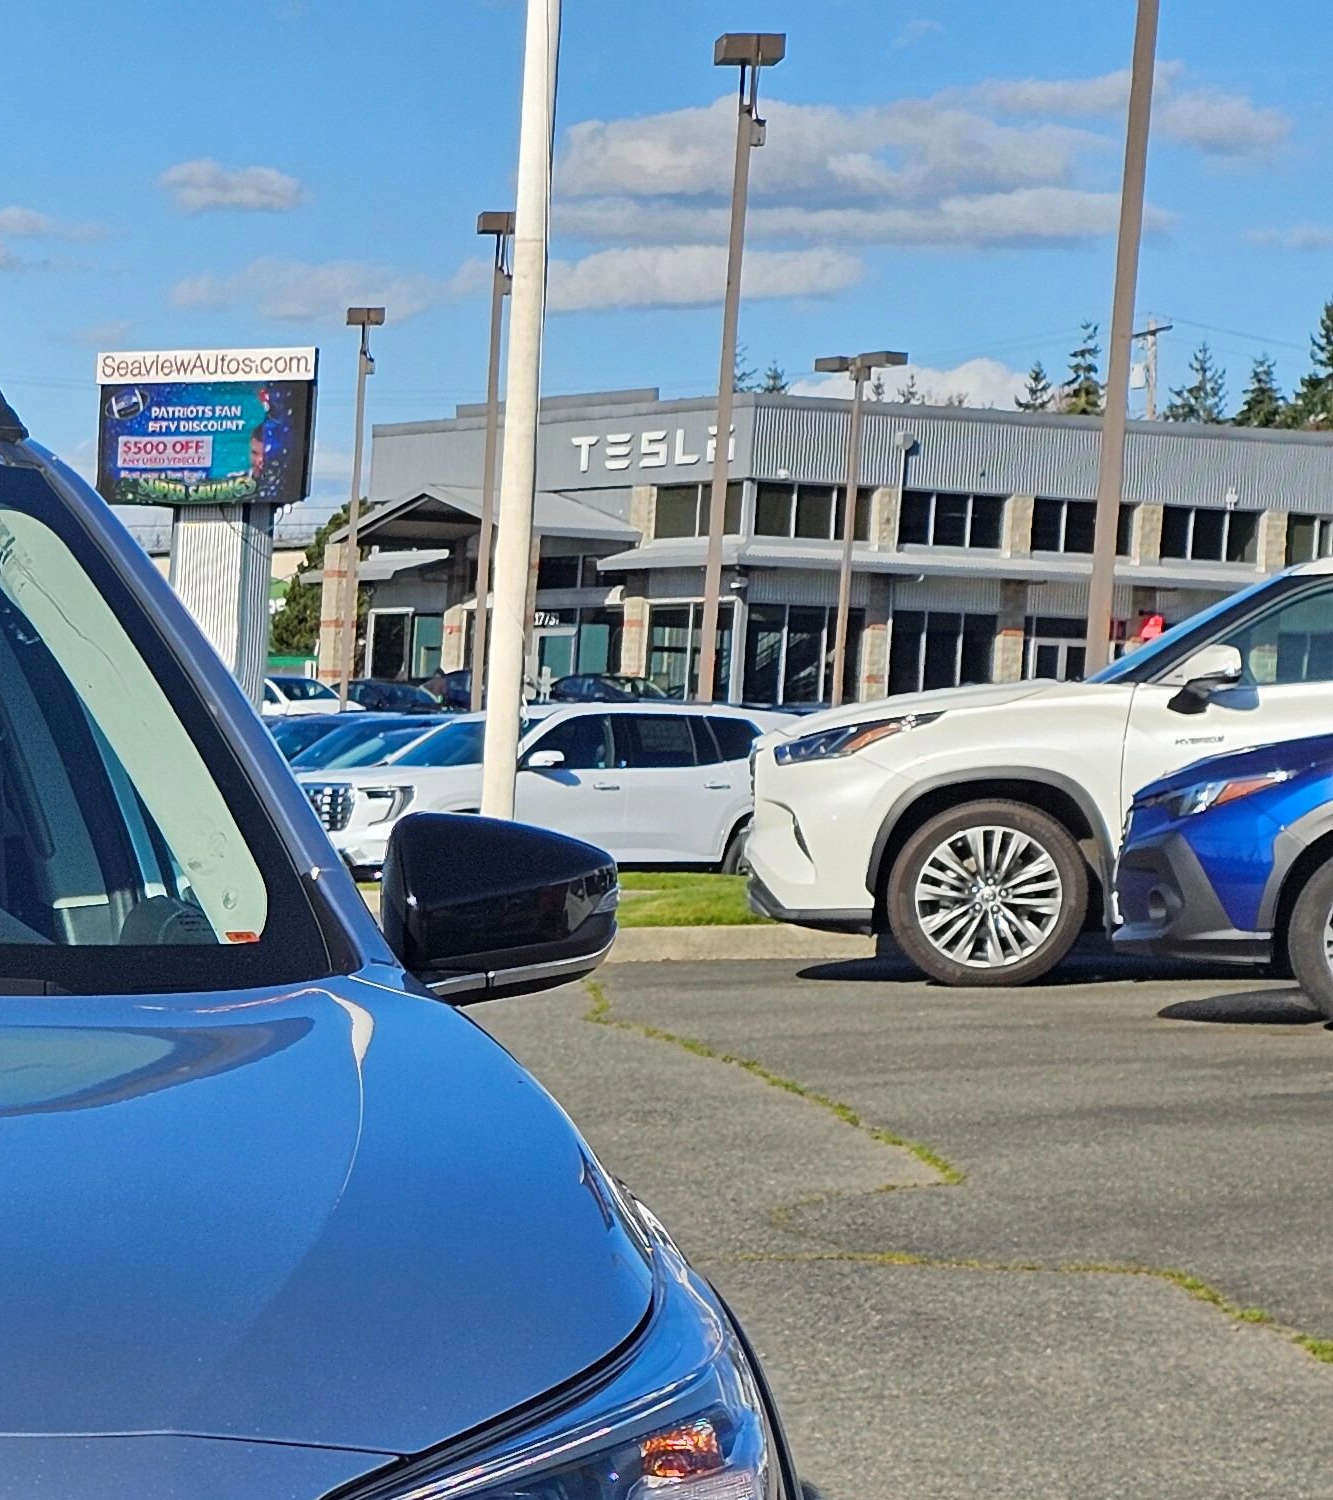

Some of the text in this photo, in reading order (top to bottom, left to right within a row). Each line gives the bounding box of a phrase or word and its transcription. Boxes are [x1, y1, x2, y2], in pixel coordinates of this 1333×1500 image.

[151, 405, 241, 419] PATRIOTS FAN
[179, 420, 245, 432] DISCOUNT
[122, 440, 204, 455] $500 OFF
[571, 424, 736, 473] TESLA
